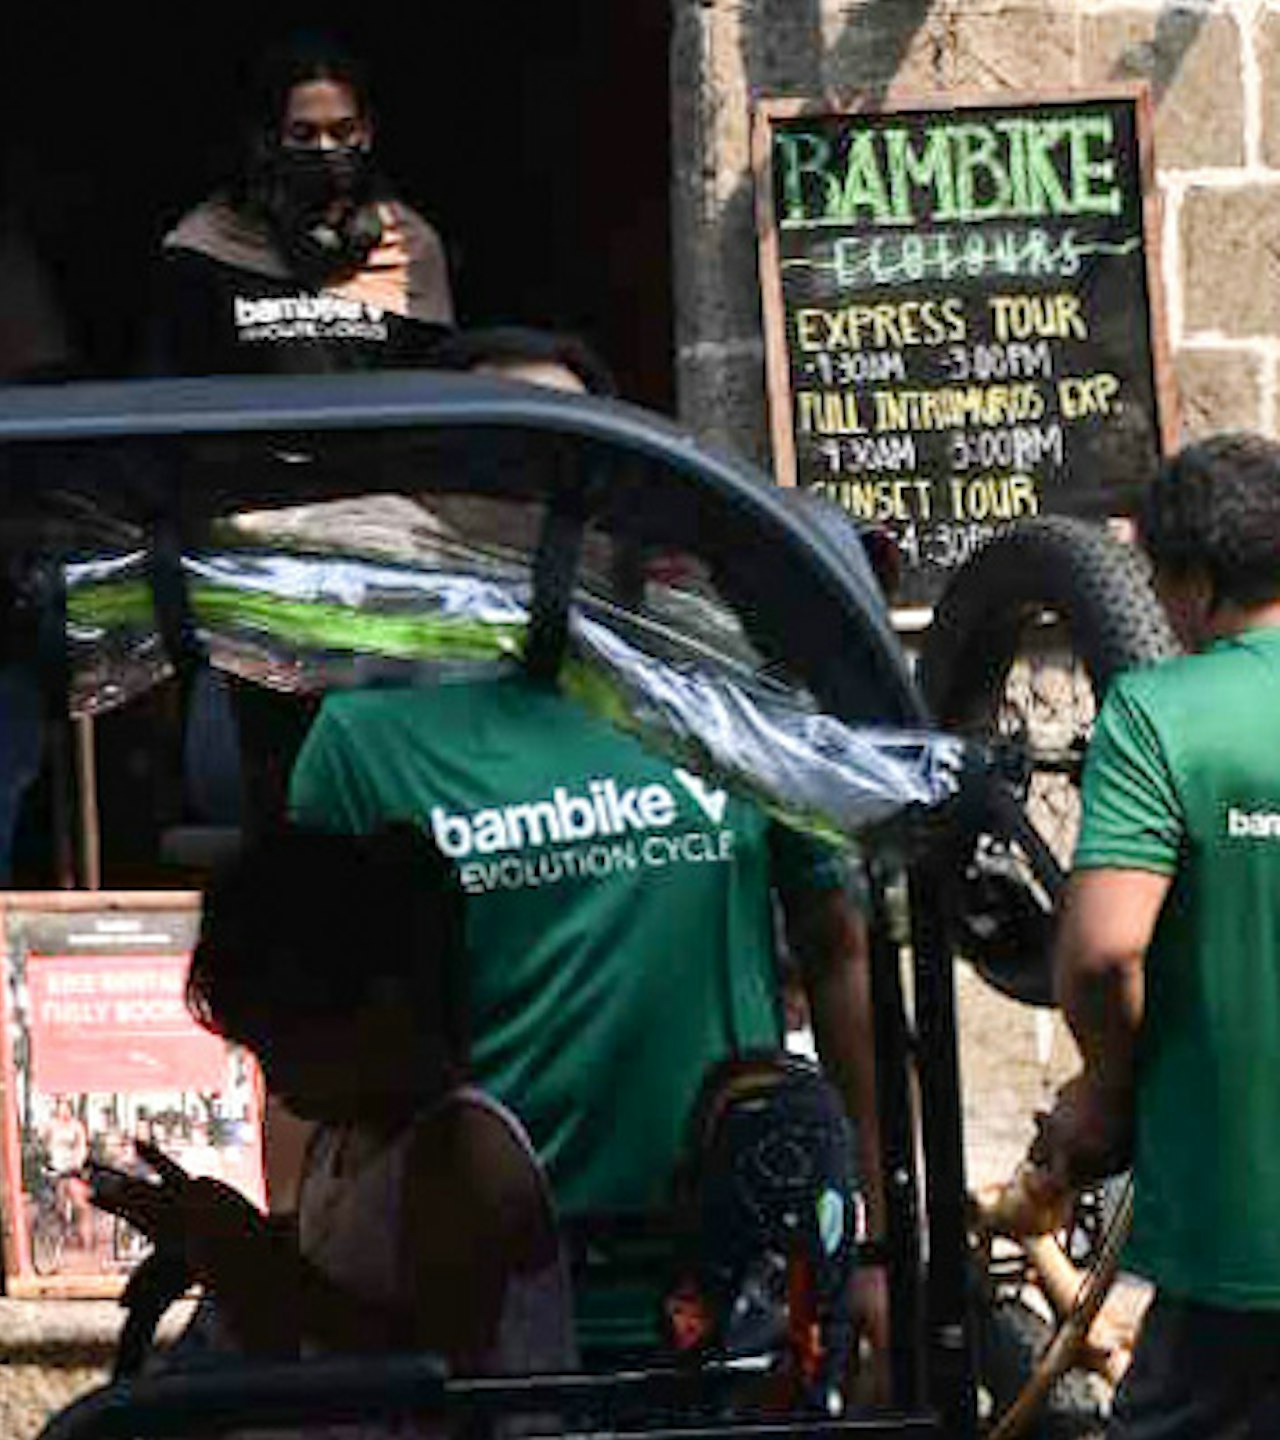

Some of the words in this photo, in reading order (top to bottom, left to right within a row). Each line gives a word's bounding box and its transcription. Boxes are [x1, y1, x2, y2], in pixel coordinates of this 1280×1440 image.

[777, 117, 1122, 228] BAMBIKE
[834, 229, 1082, 285] ECOTOURS
[797, 298, 968, 352] EXPRESS
[990, 293, 1088, 342] TOUR
[797, 390, 869, 435] FULL
[874, 382, 1045, 432] INTRAMUROS
[950, 473, 1040, 520] TOUR
[431, 779, 676, 858] bambike
